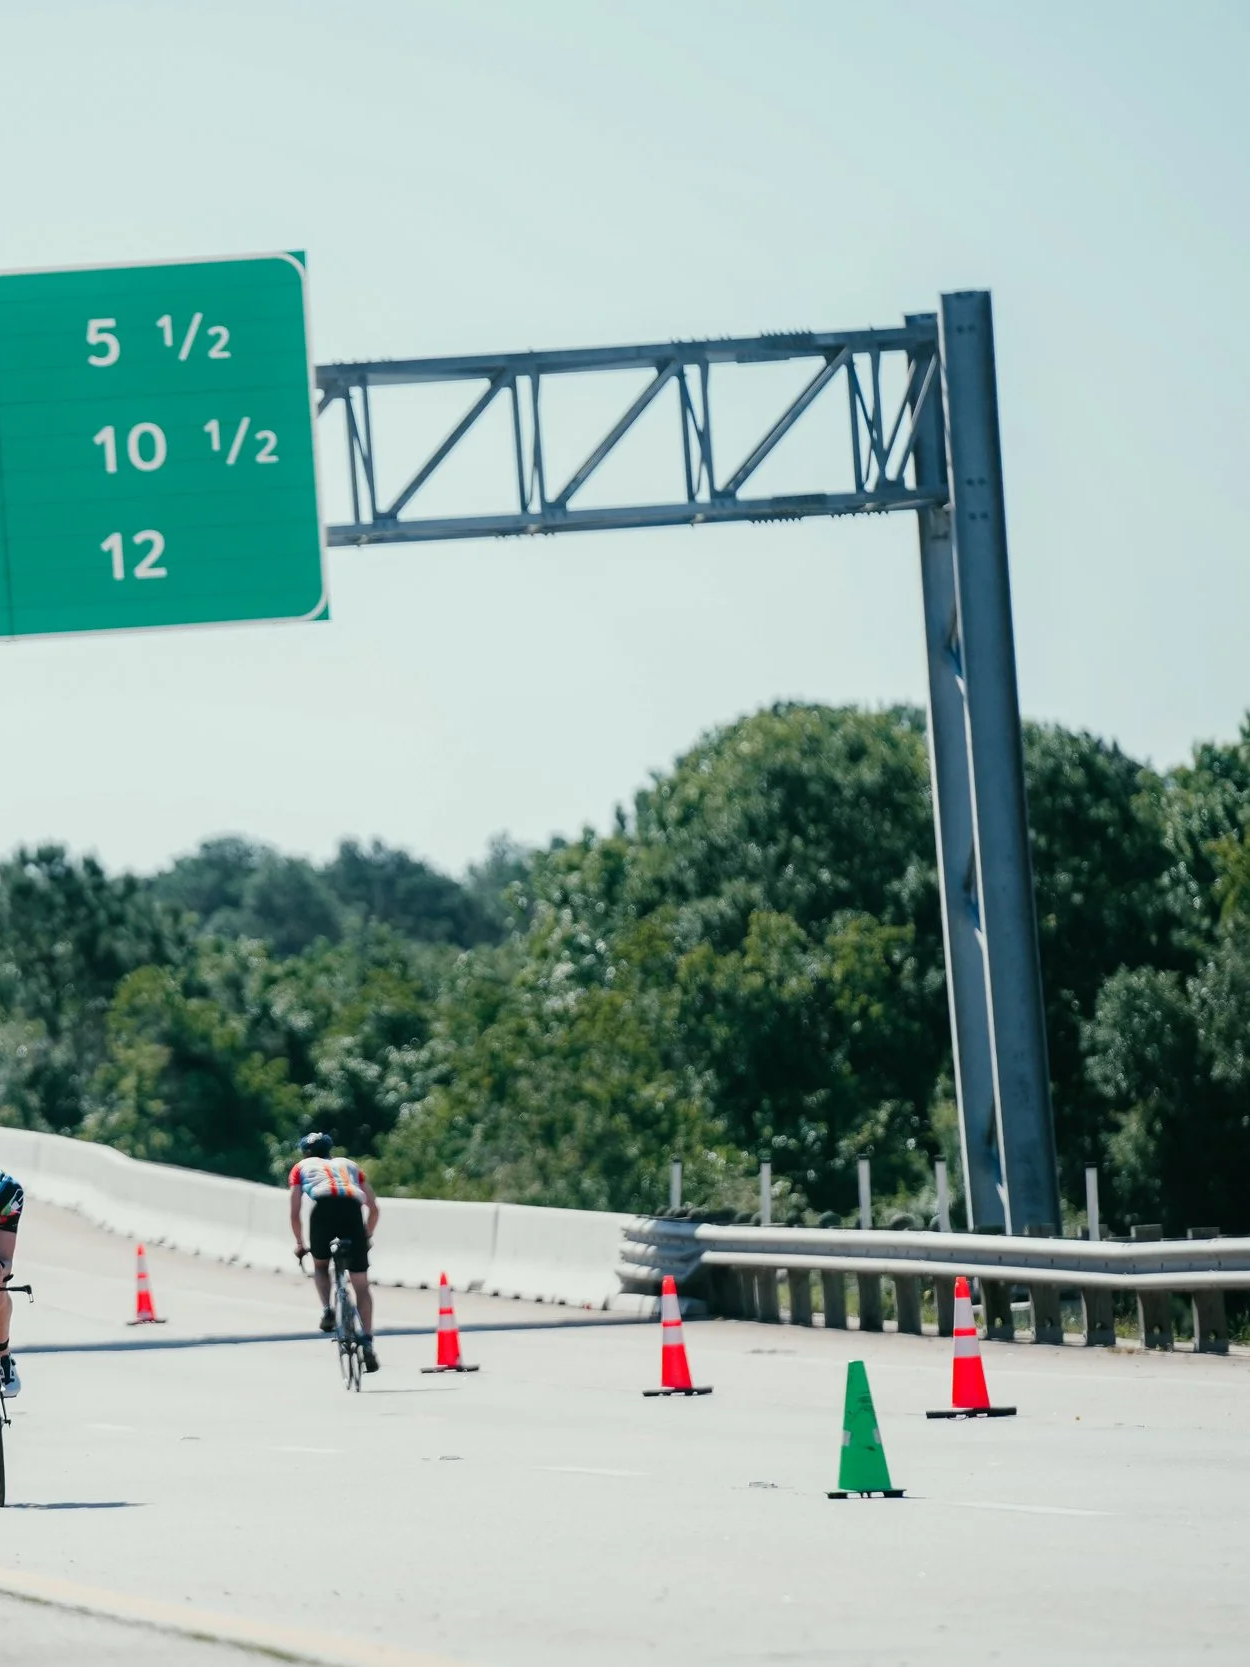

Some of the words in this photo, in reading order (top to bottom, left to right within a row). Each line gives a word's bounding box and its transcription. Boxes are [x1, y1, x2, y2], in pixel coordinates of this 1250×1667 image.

[86, 318, 120, 368] 5
[92, 422, 168, 474] 10
[100, 529, 168, 581] 12
